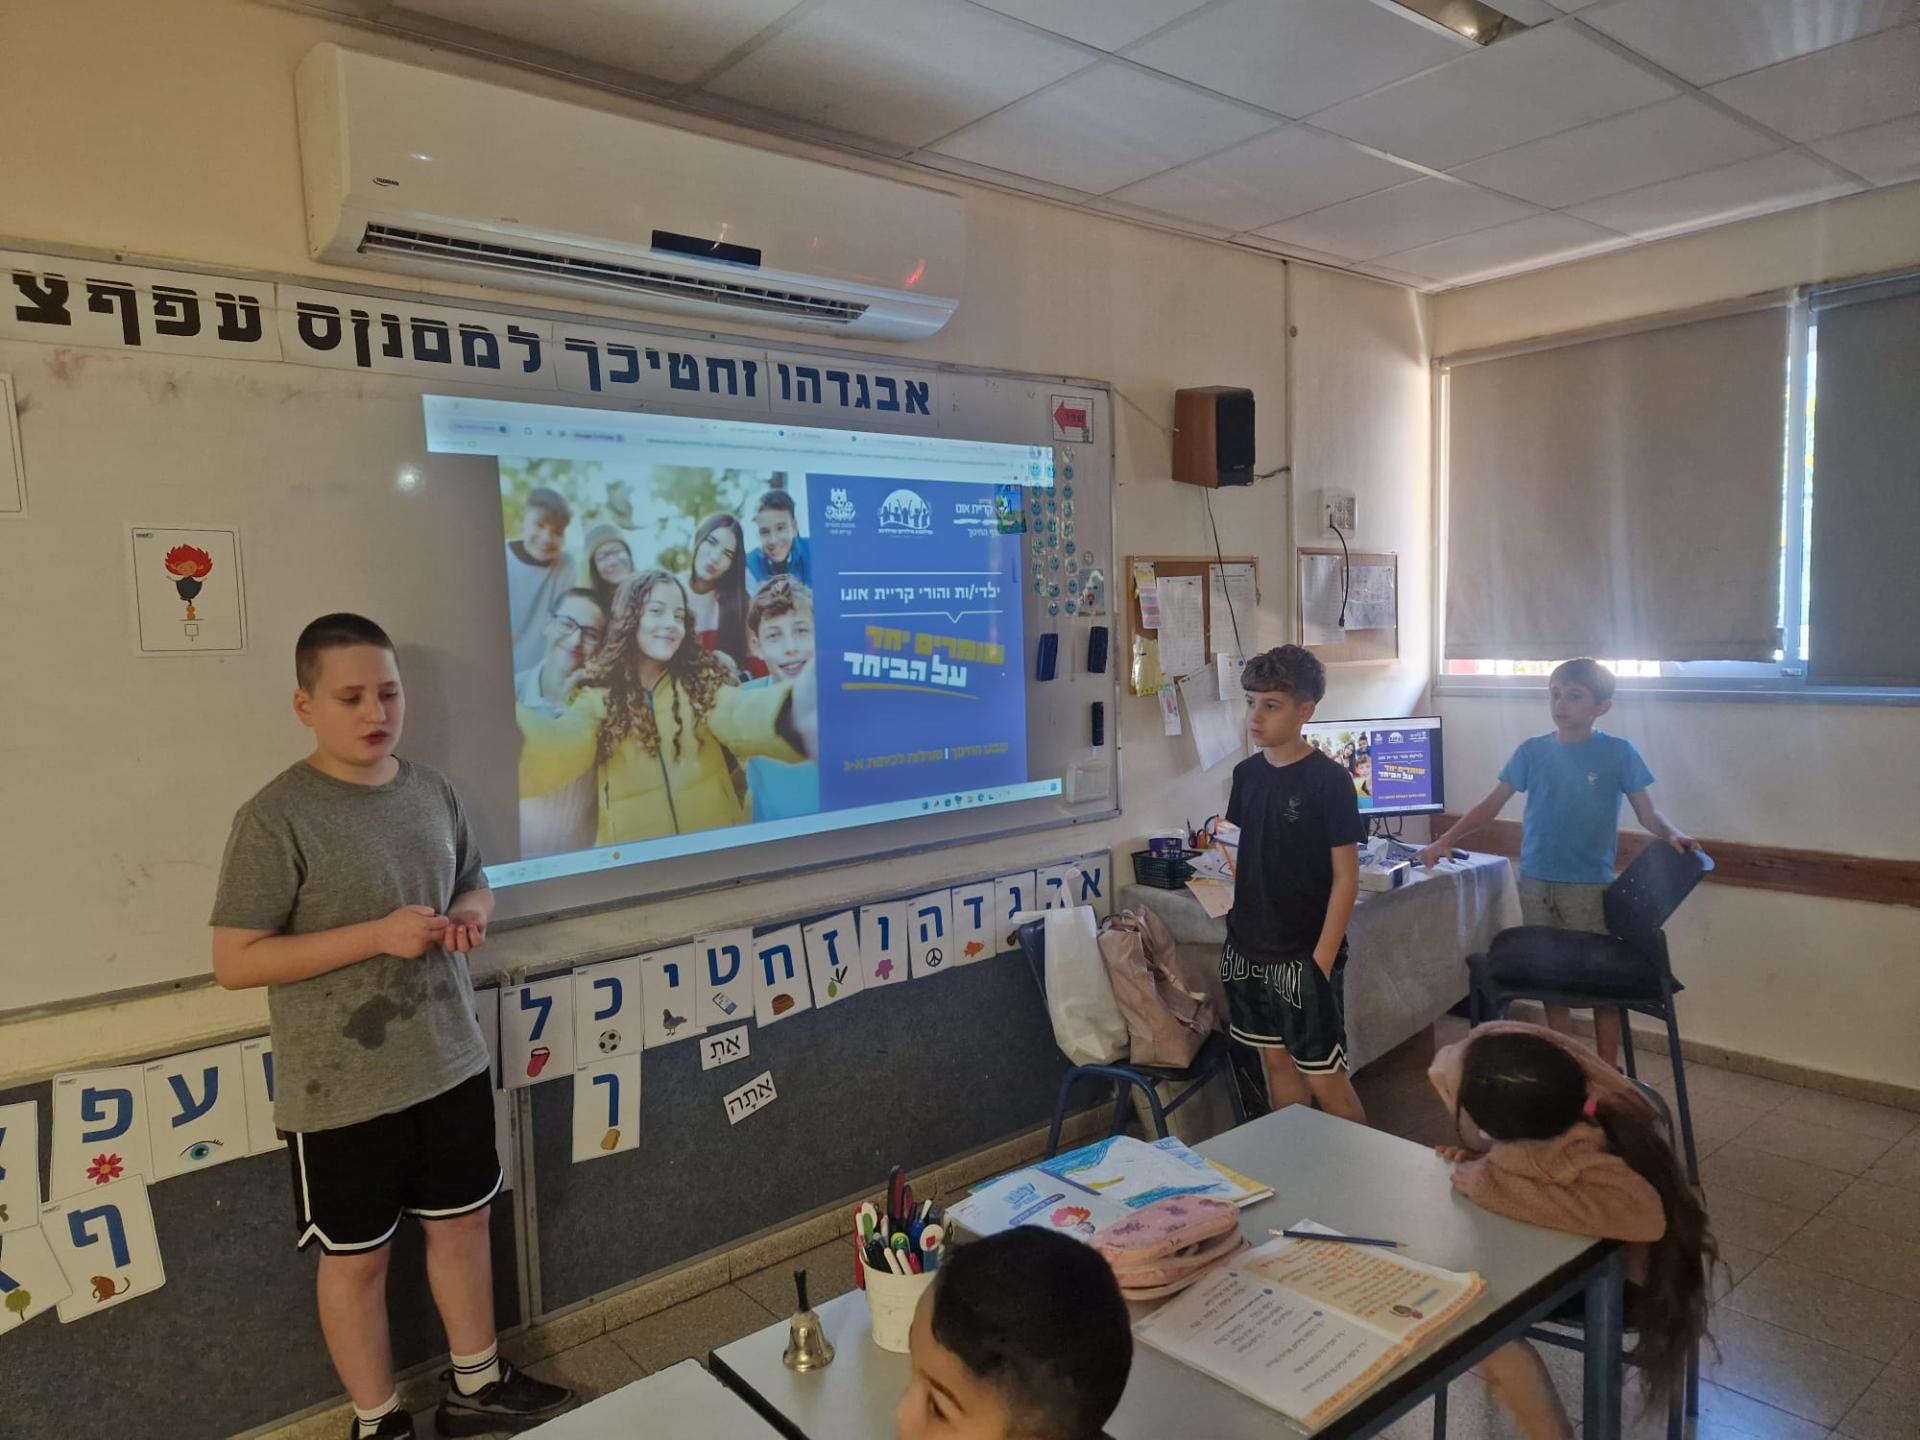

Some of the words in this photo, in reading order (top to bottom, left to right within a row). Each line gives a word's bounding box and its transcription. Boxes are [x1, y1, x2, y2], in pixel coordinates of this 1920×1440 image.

[564, 337, 758, 398] זחטיכך
[778, 362, 931, 416] אבגדהו
[840, 587, 869, 601] אונו
[874, 587, 915, 605] קריית
[919, 586, 951, 600] והורי
[954, 581, 1001, 600] ילדי/ות
[865, 625, 912, 653] יחד
[843, 651, 927, 682] הביחד
[930, 654, 968, 688] על
[1008, 886, 1023, 920] ג
[1081, 868, 1102, 901] א
[917, 905, 944, 943] ה
[963, 895, 984, 931] ד
[822, 928, 841, 967] ז
[878, 915, 890, 952] ו
[663, 963, 680, 988] י
[707, 944, 741, 988] ט
[758, 943, 796, 987] ח
[520, 988, 553, 1041] ל
[593, 977, 623, 1021] כ
[81, 1087, 134, 1144] פ
[167, 1066, 219, 1128] ע
[592, 1073, 620, 1127] ך
[67, 1204, 131, 1269] ף
